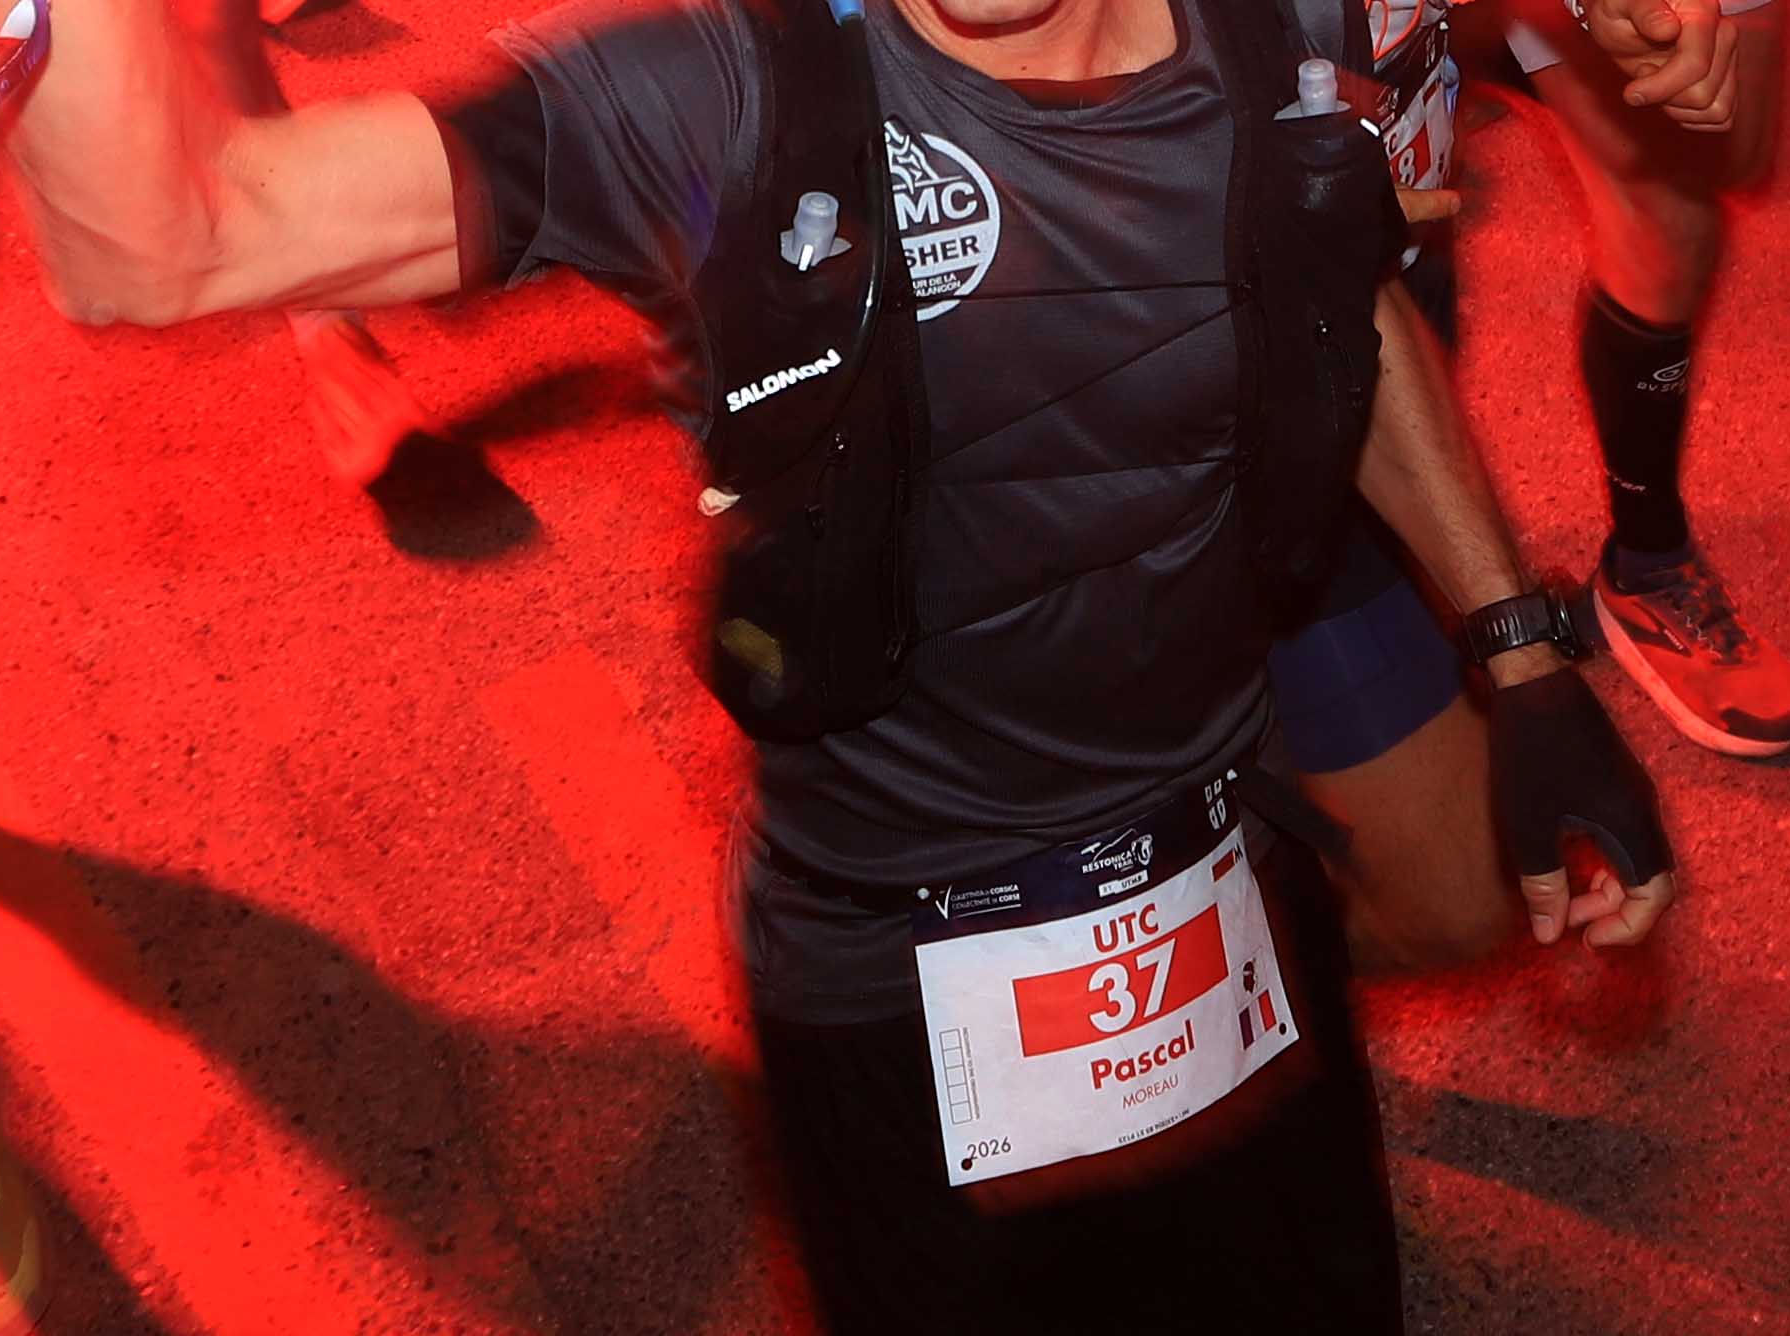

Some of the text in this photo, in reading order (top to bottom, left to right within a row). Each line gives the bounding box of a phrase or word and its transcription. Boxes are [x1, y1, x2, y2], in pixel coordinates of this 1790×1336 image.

[906, 234, 980, 270] SHER
[929, 276, 942, 287] DE
[944, 273, 957, 283] LA
[726, 349, 842, 413] SALOMON
[1082, 848, 1133, 874] RESTONICA
[1093, 903, 1159, 953] UTC
[1088, 936, 1176, 1033] 37
[1091, 1019, 1195, 1090] Pascal
[1122, 1073, 1179, 1110] MOREAU
[967, 1136, 1012, 1161] 2026
